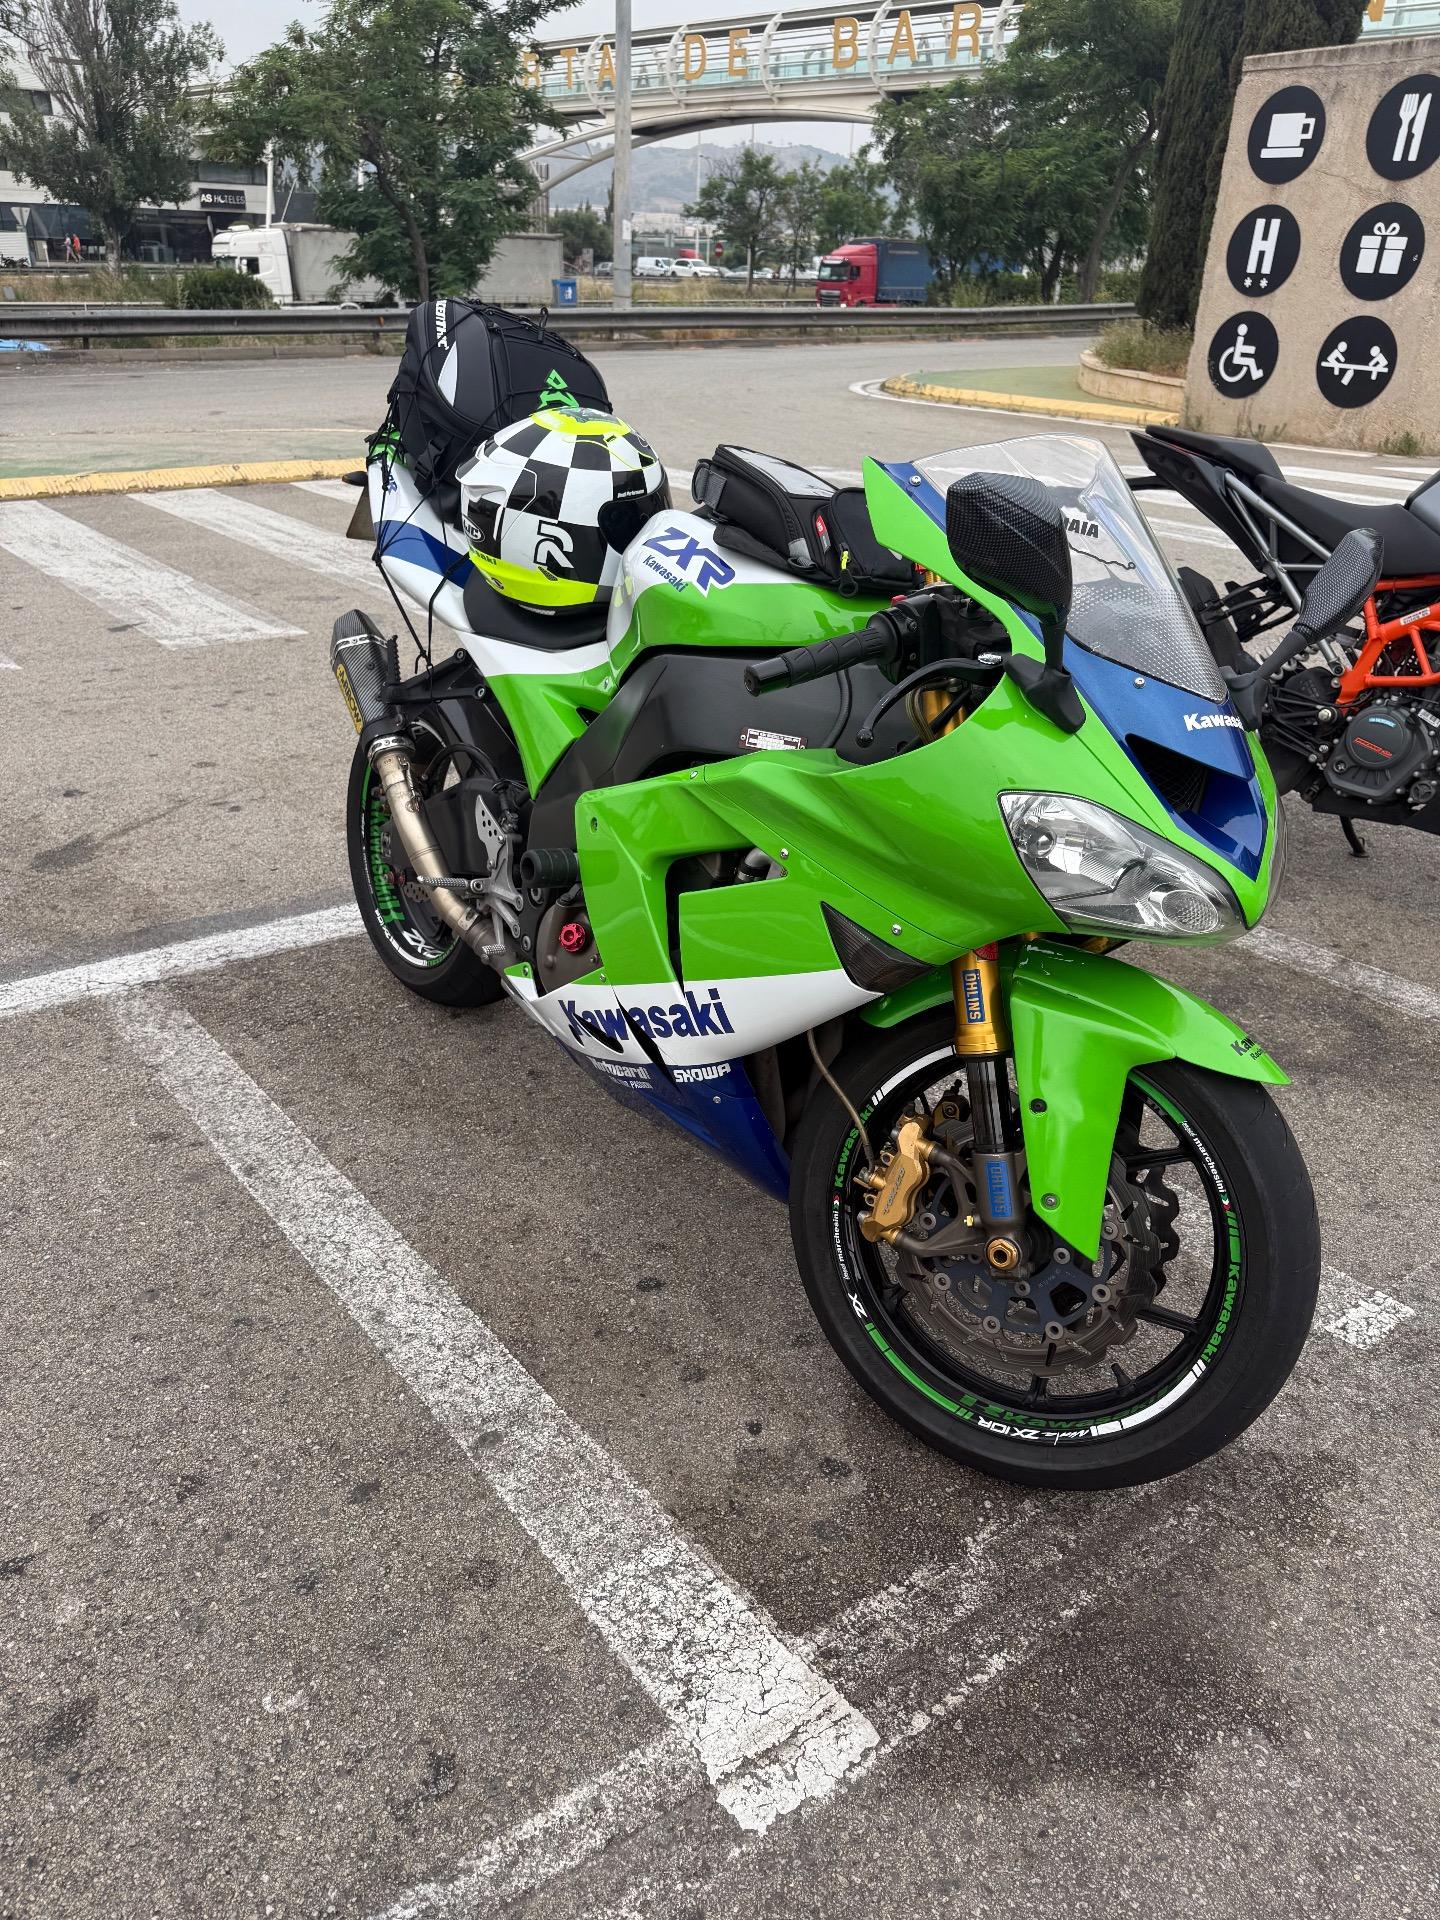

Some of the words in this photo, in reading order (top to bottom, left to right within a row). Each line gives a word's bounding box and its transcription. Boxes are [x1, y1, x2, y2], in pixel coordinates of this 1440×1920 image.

[684, 29, 750, 80] DE
[832, 3, 983, 69] BAR
[200, 193, 213, 203] AS
[213, 194, 246, 205] HOTELES
[1246, 218, 1281, 275] H
[462, 518, 482, 540] JC
[642, 526, 736, 592] ZXR
[642, 554, 689, 593] Kawasaki
[338, 669, 361, 723] ARROW
[558, 987, 735, 1041] Kawasaki
[673, 1062, 732, 1083] SHOWA
[834, 1103, 875, 1188] Kawaski
[1193, 1136, 1227, 1194] marchesini
[832, 1210, 845, 1263] marchesini
[1200, 1262, 1240, 1363] Kawasaki
[977, 1415, 1041, 1440] ZX10R
